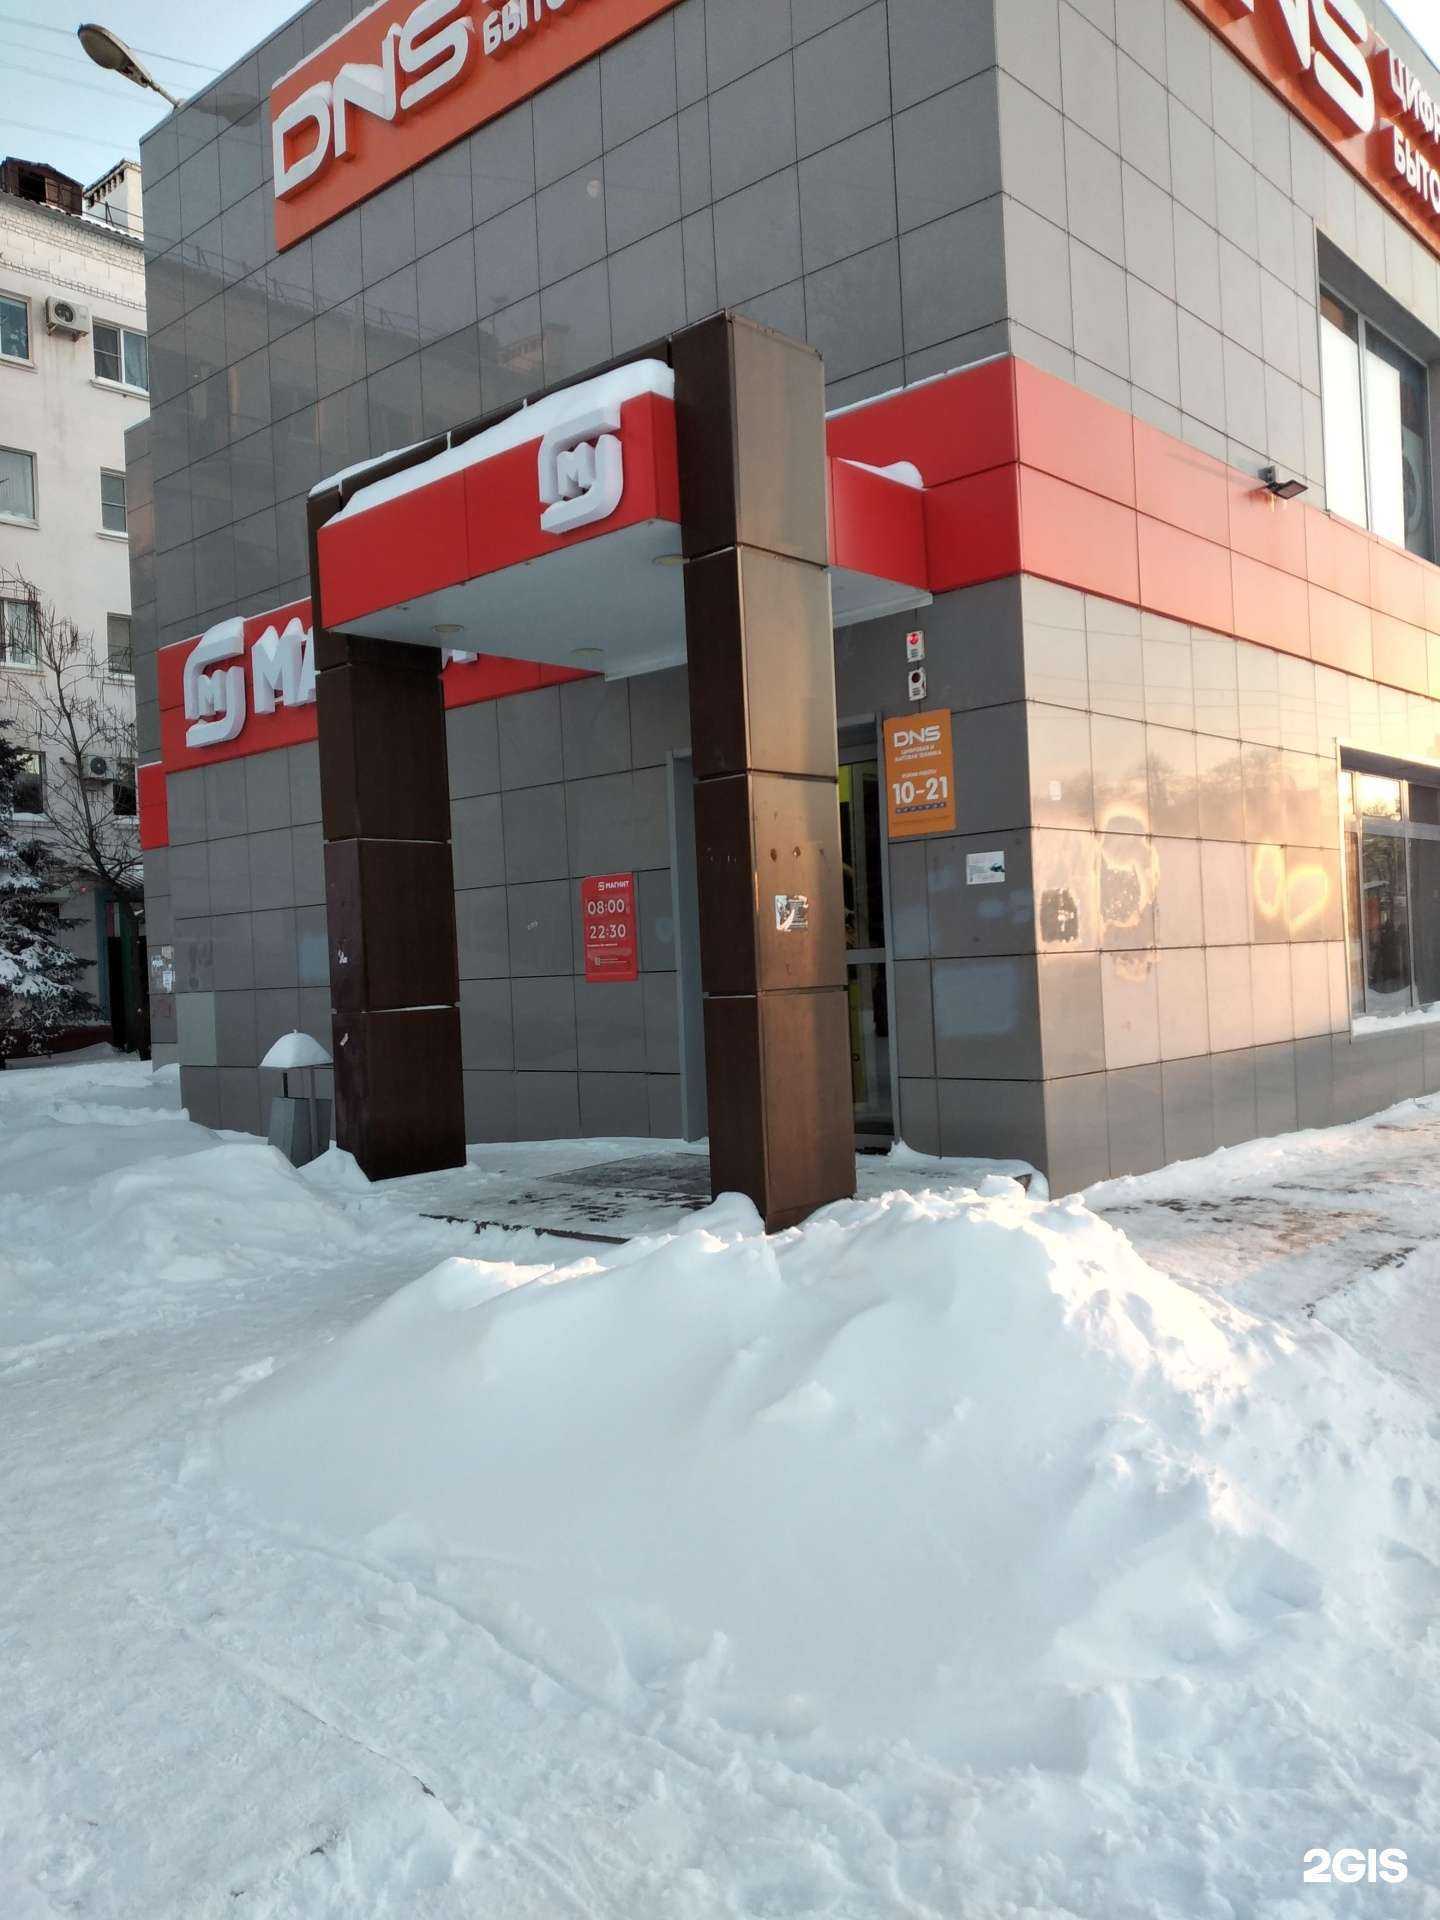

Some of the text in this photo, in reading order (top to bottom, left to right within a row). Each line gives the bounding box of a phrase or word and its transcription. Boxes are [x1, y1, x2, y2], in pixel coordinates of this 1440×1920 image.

[272, 0, 471, 200] DNS
[894, 725, 941, 747] DNS
[587, 899, 625, 915] 08:00
[590, 924, 627, 939] 22:30
